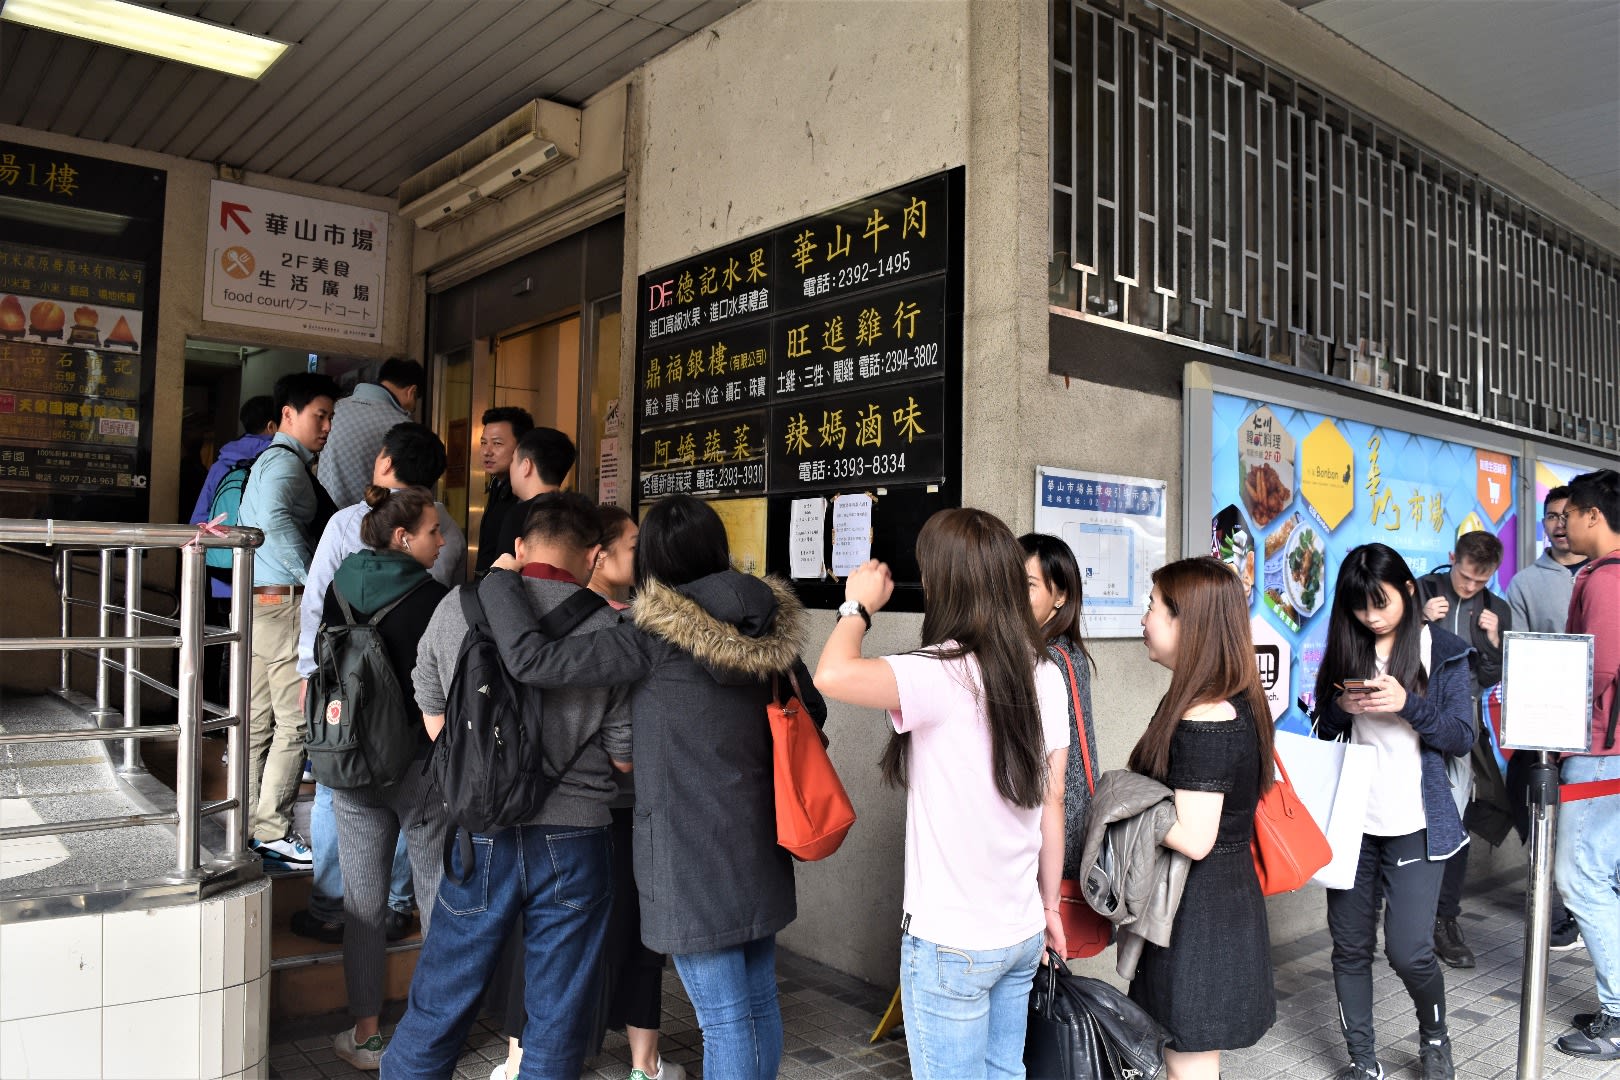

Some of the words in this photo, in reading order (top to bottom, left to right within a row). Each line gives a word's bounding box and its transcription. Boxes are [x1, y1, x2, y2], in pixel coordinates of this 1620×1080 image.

[265, 212, 373, 252] 華山市場
[791, 196, 927, 275] 華山牛肉
[281, 252, 350, 278] 2F美食
[648, 279, 674, 312] DF
[676, 248, 768, 305] 德記水果
[223, 288, 253, 304] food
[258, 269, 369, 302] 生活廣場
[787, 300, 921, 359] 旺進雞行
[646, 341, 728, 389] 鼎福銀樓
[784, 396, 926, 456] 辣媽滷味
[1253, 414, 1272, 433] 仁川
[654, 423, 750, 469] 阿嬌蔬菜
[1264, 449, 1272, 461] 2F
[643, 471, 692, 495] 各種新鮮蔬菜
[1316, 465, 1339, 480] Bonbon
